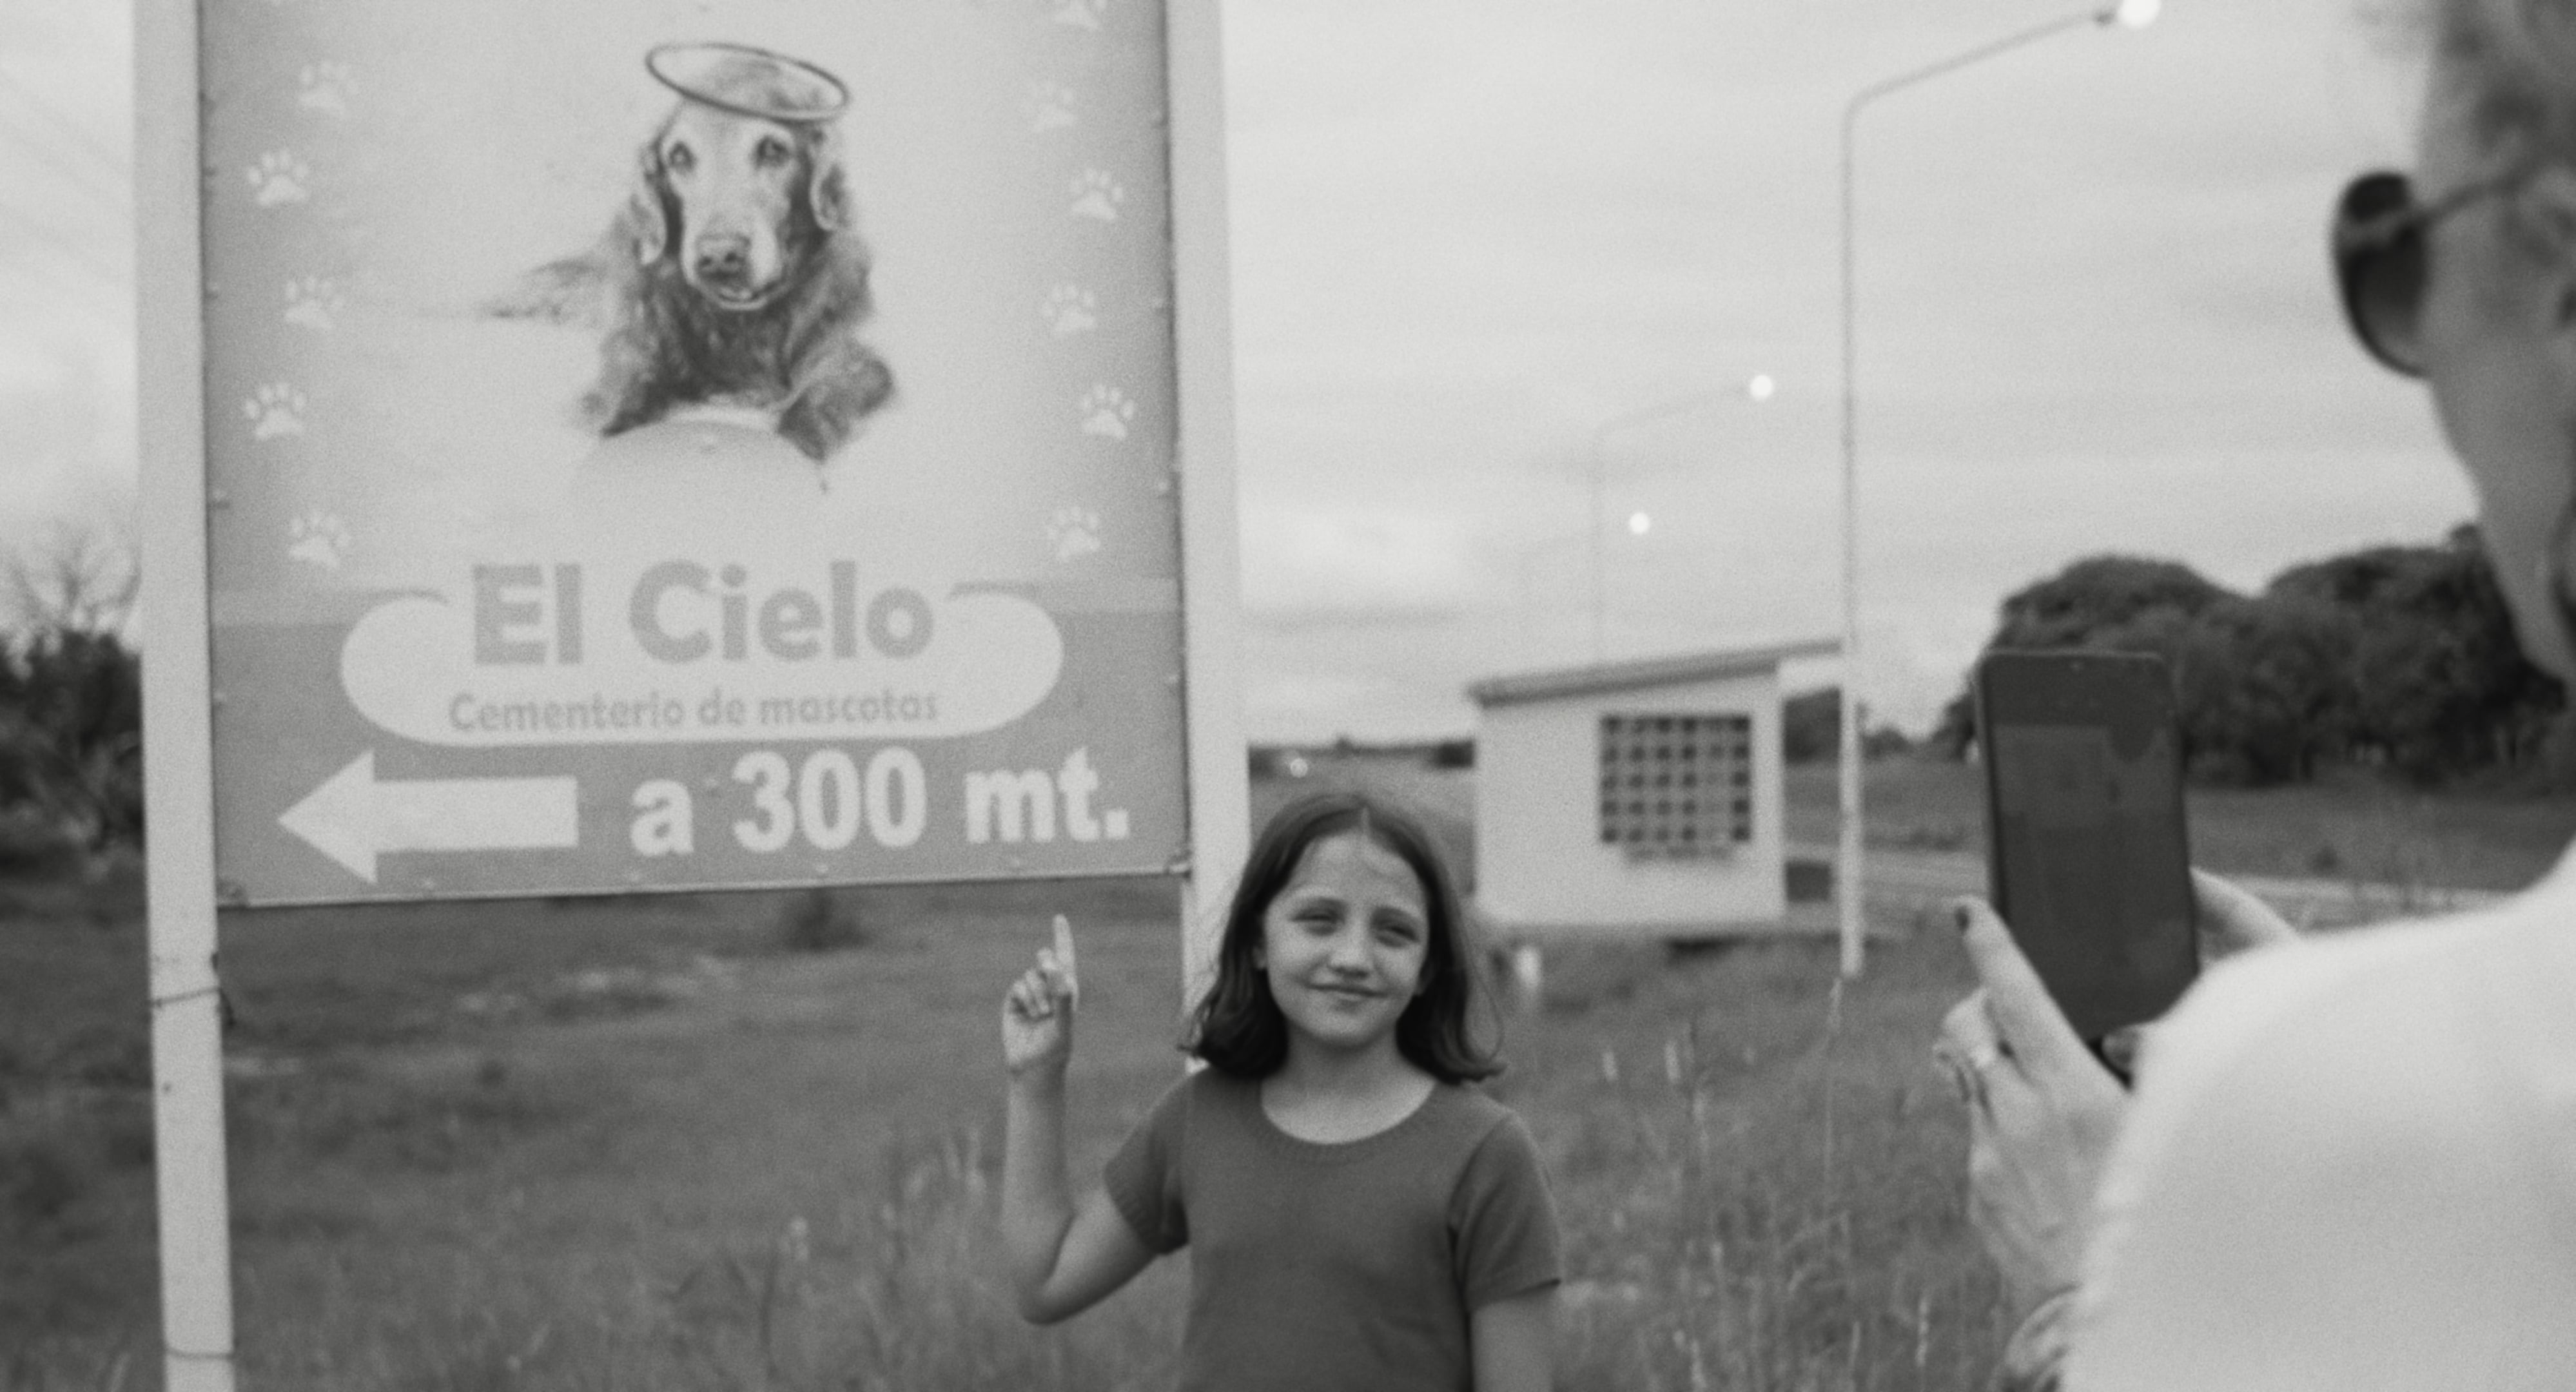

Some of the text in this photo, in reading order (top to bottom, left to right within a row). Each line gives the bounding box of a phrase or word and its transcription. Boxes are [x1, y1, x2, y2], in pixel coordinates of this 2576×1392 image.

[473, 561, 935, 664] El Cielo
[451, 687, 939, 731] Cementerio de mascotas
[630, 745, 1130, 856] a 300 mt.
